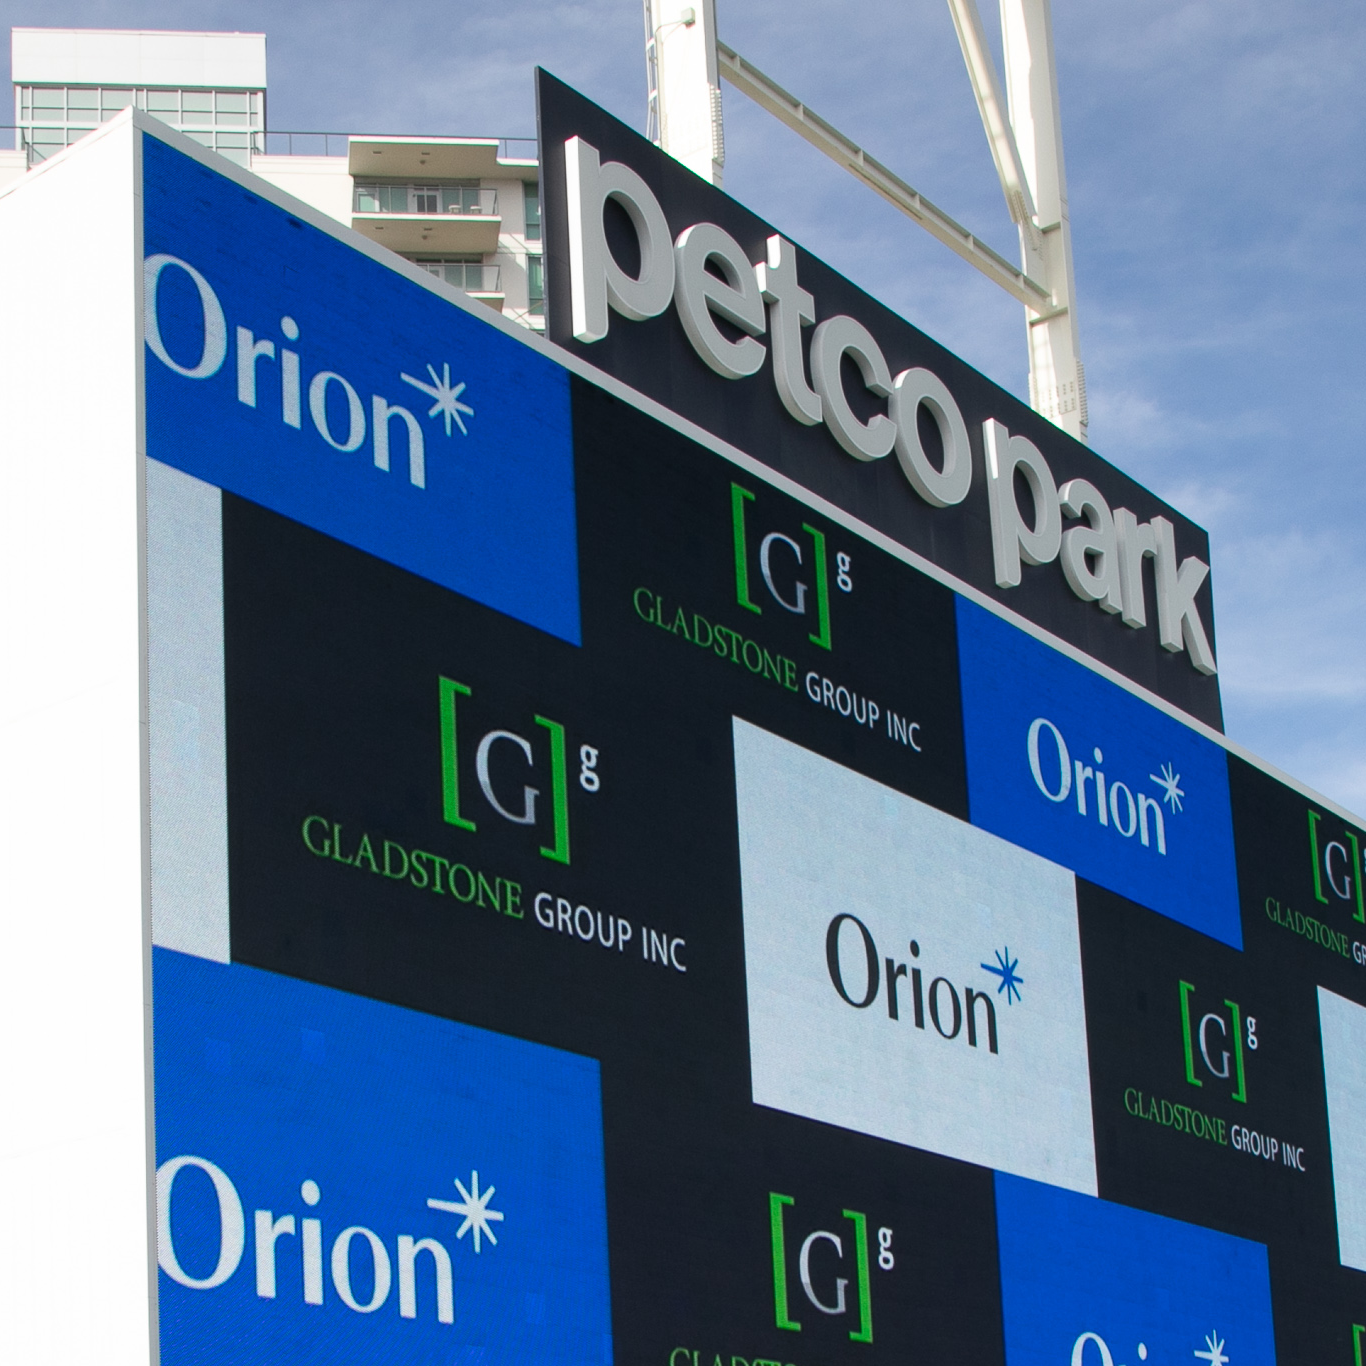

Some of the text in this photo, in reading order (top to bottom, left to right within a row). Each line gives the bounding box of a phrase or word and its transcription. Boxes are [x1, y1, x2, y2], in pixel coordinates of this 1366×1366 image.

[143, 254, 427, 489] Orion
[564, 136, 1217, 675] petco park
[634, 586, 922, 751] GLADSTONE GROUP INC
[1027, 718, 1167, 856] Orion
[302, 815, 687, 972] GLADSTONE GROUP INC
[1265, 897, 1351, 959] GLADSTONE
[825, 912, 1000, 1055] Orion
[1124, 1087, 1306, 1172] GLADSTONE GROUP INC
[156, 1155, 455, 1325] Orion
